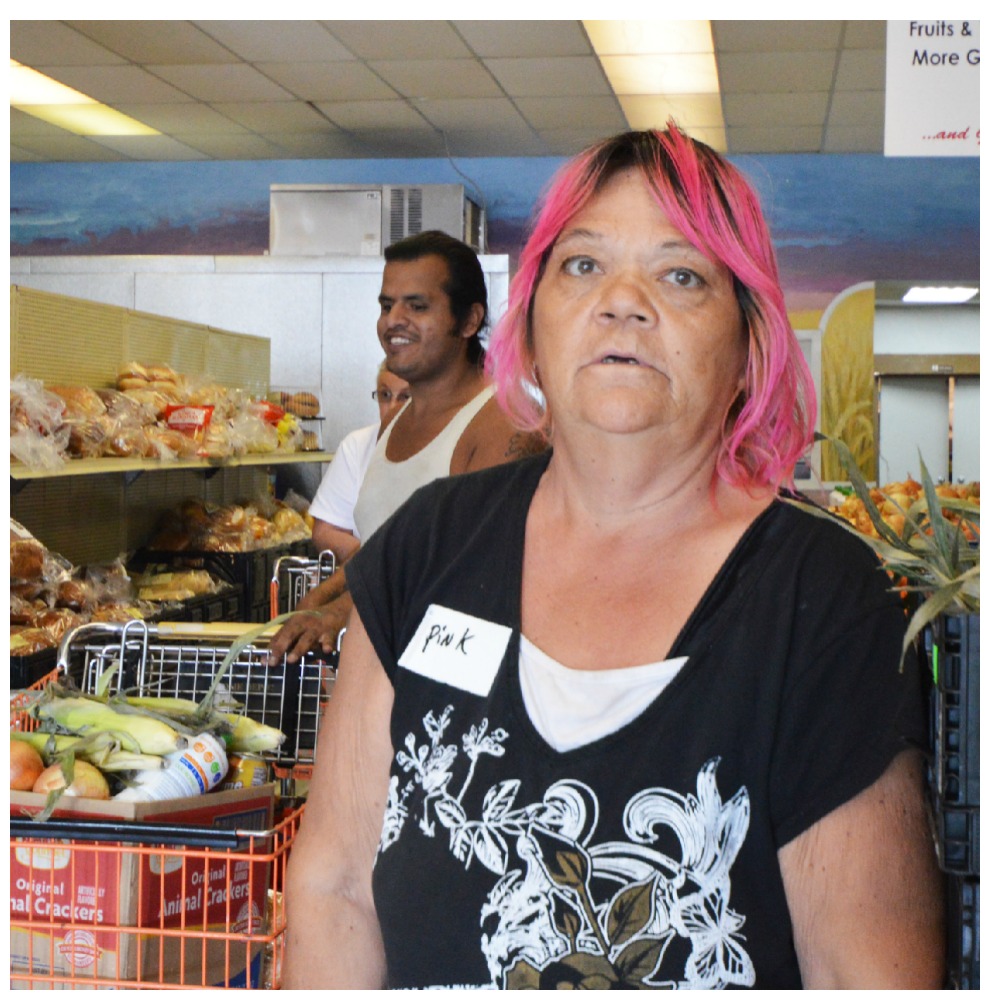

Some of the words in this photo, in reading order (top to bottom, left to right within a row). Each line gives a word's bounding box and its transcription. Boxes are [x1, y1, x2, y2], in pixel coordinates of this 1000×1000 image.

[909, 20, 954, 37] Fruits
[960, 21, 972, 37] &
[912, 49, 960, 66] More
